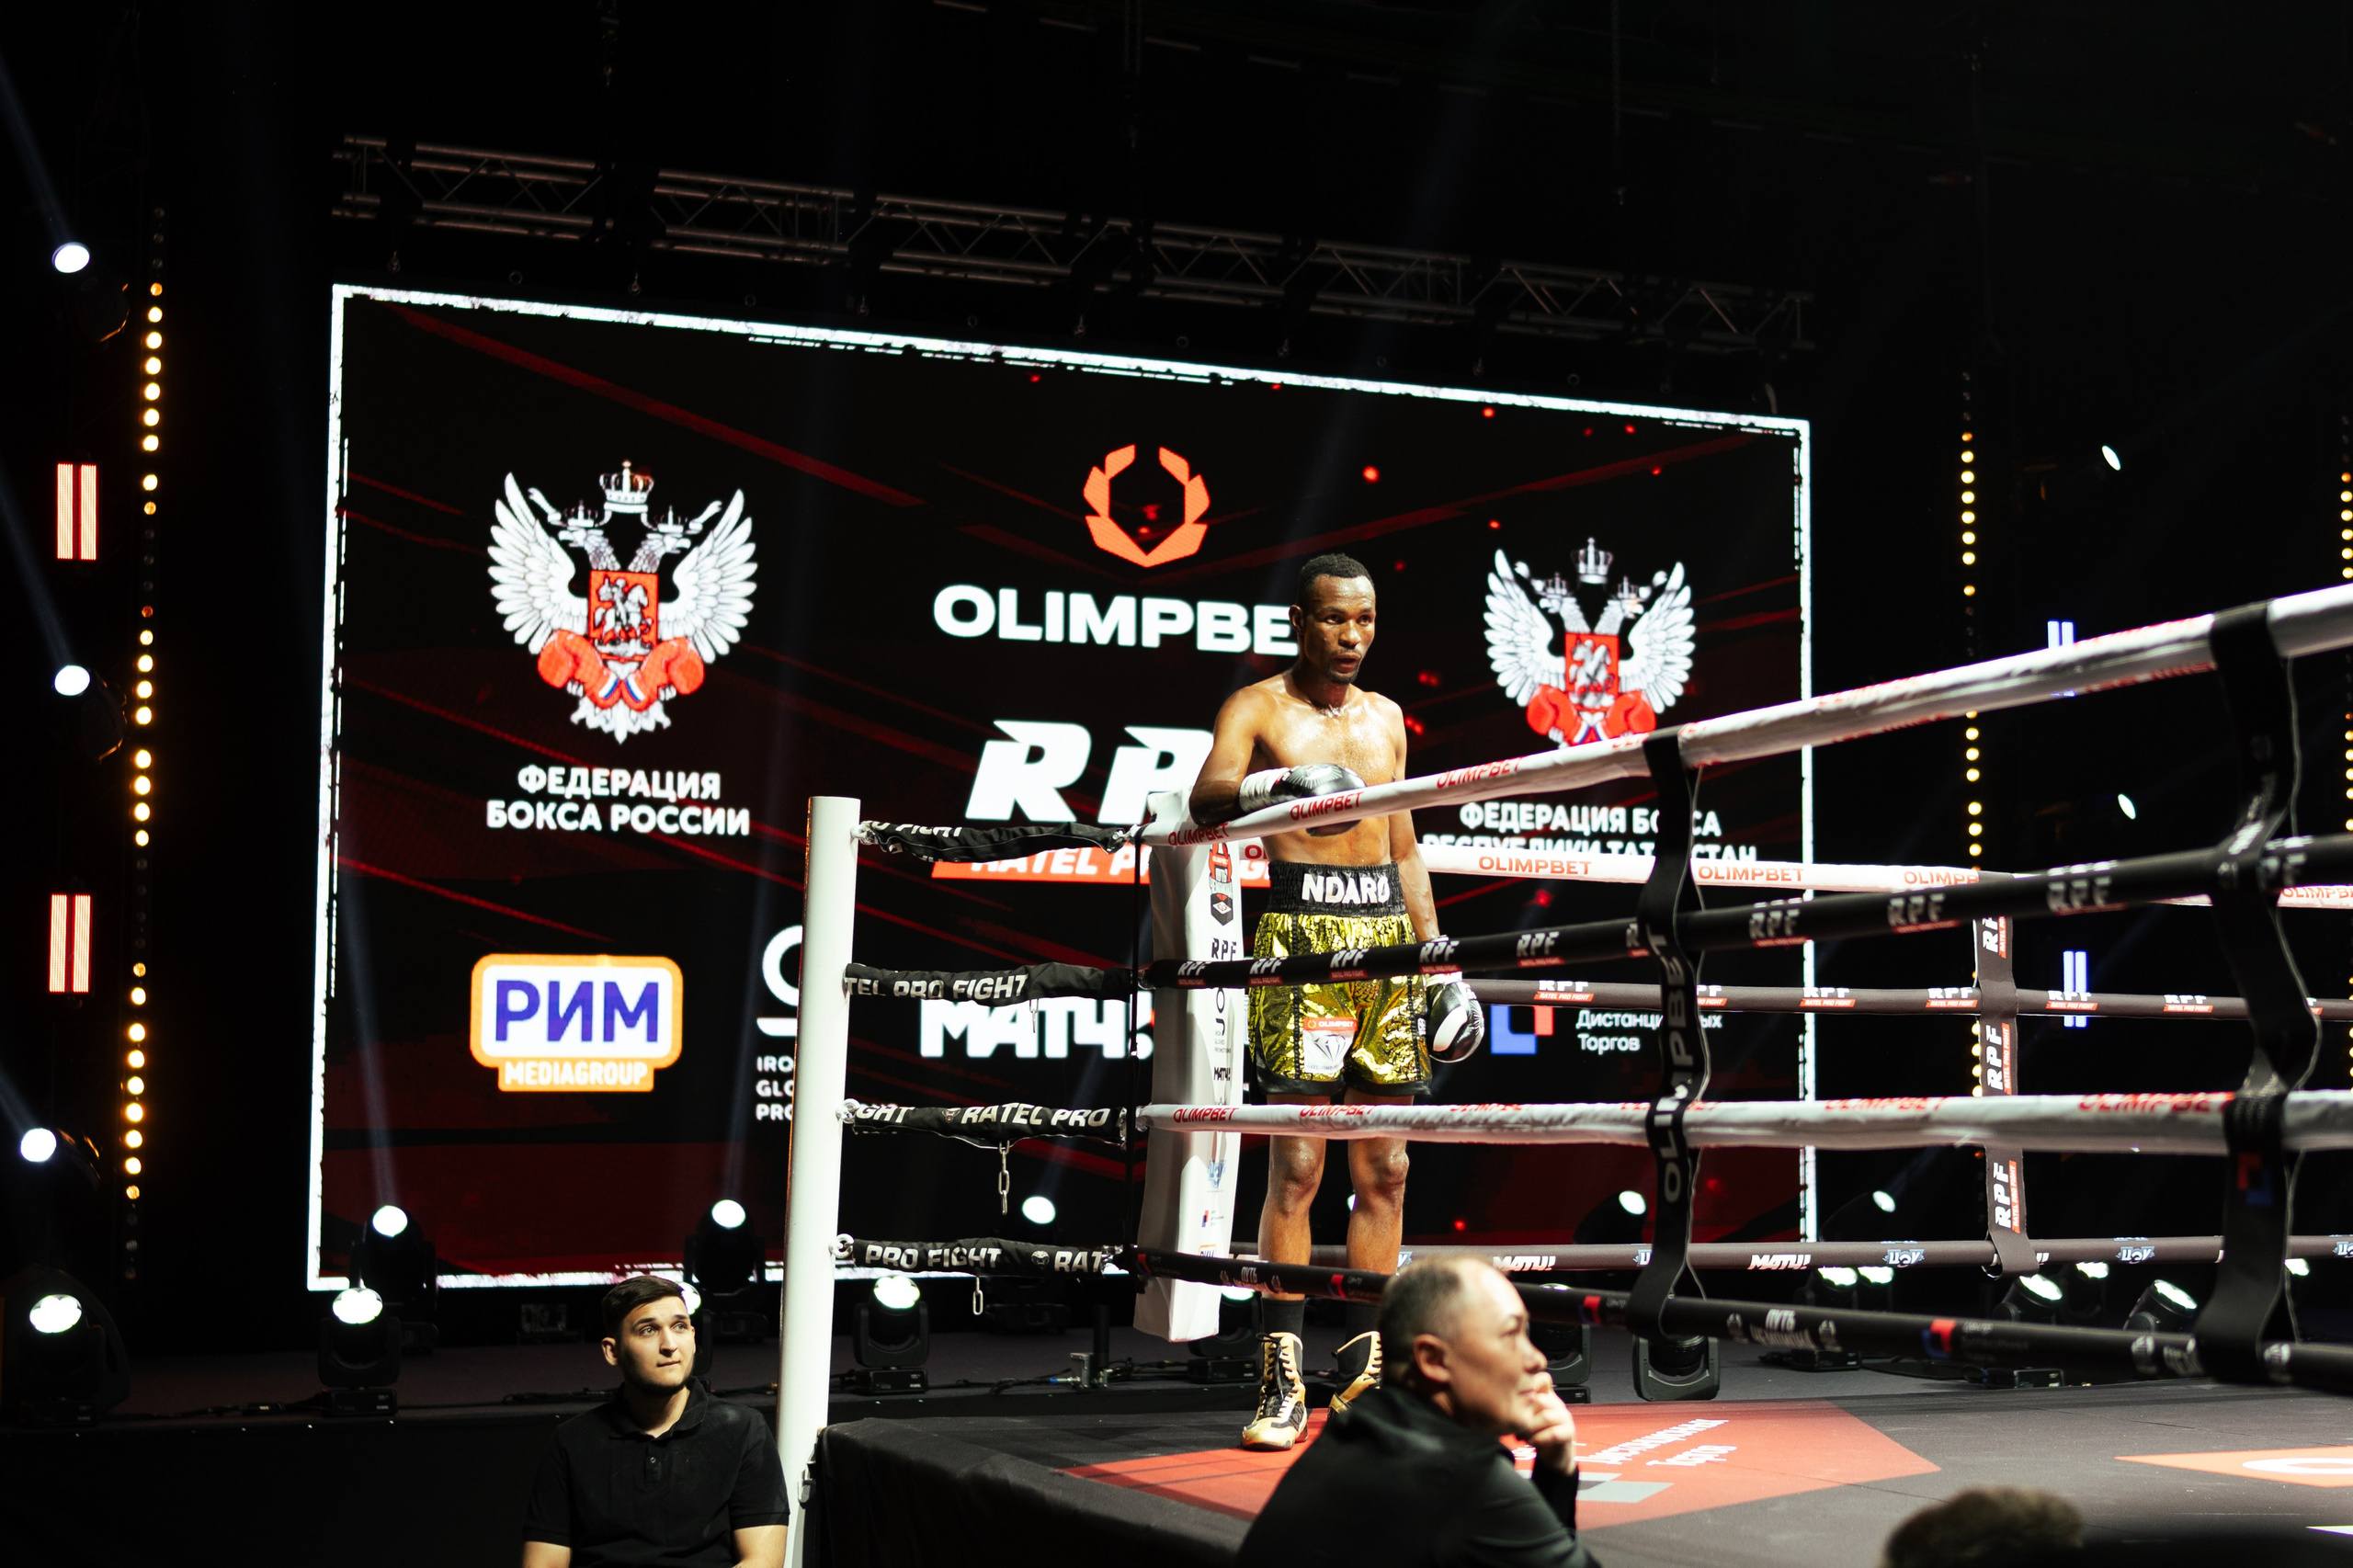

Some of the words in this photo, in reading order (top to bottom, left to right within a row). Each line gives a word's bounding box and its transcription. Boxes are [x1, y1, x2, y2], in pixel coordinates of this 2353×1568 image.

[933, 585, 1300, 656] OLIMPBE
[517, 765, 721, 801] ФЕДЕРАЦИЯ
[965, 720, 1214, 824] RP
[1437, 756, 1522, 789] OLIMPBET
[486, 801, 603, 830] БОКСА
[610, 804, 751, 835] РОССИИ
[1290, 792, 1365, 822] OLIMPBET
[1460, 801, 1627, 836] ФЕДЕРАЦИЯ
[1632, 807, 1722, 837] БСА
[1167, 823, 1229, 846] OLIMPBET
[1478, 855, 1592, 876] OLIMPBET
[1698, 866, 1804, 882] OLIMPBET
[1904, 871, 1979, 885] OLIMPB
[2281, 887, 2353, 898] OLIMPB
[1517, 931, 1560, 957] RPF
[1983, 917, 1998, 953] RP
[1211, 937, 1237, 960] RPF
[1330, 949, 1370, 969] RPF
[1419, 940, 1460, 963] RPF
[1177, 961, 1211, 976] RPF
[1250, 957, 1287, 974] RPF
[845, 977, 886, 995] TEL
[893, 980, 944, 999] PRO
[952, 974, 1029, 999] FIGHT
[1539, 980, 1589, 992] RPF
[1697, 984, 1722, 996] PF
[1803, 987, 1850, 999] RPF
[1927, 987, 1973, 999] RPF
[2048, 990, 2091, 1001] RPF
[495, 980, 659, 1042] РИМ
[1575, 1009, 1722, 1031] Дистанциых
[1577, 1033, 1641, 1055] Торгов
[756, 1055, 794, 1073] IRO
[1646, 922, 1694, 1203] OLIPBET
[1985, 1025, 2004, 1091] RPF
[504, 1061, 648, 1085] MEDIAGROUP
[2004, 1068, 2012, 1090] RATEL
[961, 1103, 1043, 1125] RATEL
[1050, 1108, 1110, 1127] PRO
[1173, 1108, 1239, 1124] OLIMPBET
[1994, 1162, 2011, 1229] RPF
[865, 1244, 918, 1269] PRO
[927, 1247, 1002, 1269] FIGHT
[1054, 1250, 1103, 1273] RAT
